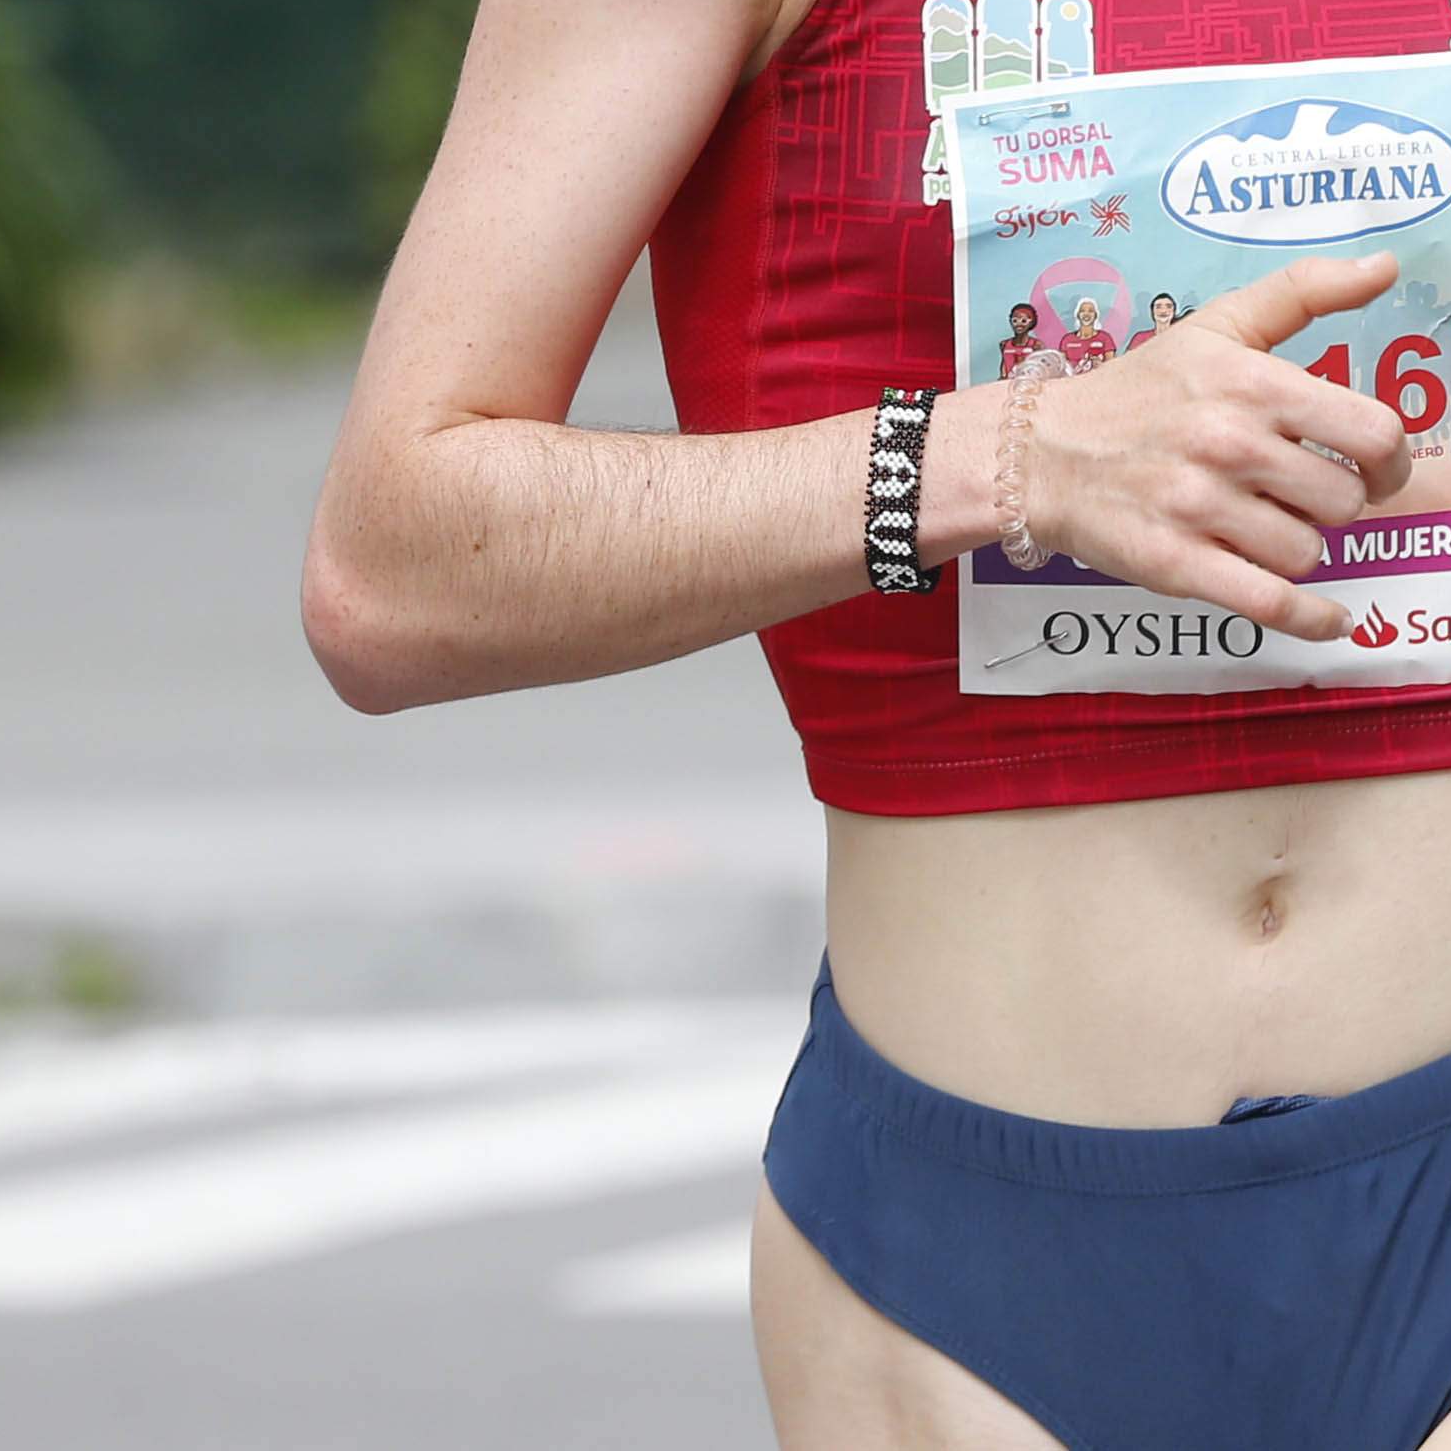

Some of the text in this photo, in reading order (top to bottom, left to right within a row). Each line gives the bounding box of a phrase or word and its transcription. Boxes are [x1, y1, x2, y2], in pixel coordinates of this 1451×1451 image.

[993, 122, 1113, 153] TU DORSAL
[1231, 141, 1434, 168] CENTRAL LECHERA
[999, 145, 1115, 185] SUMA
[1185, 160, 1445, 216] ASTURIANA
[994, 200, 1079, 238] gijón
[869, 406, 926, 592] LAUR
[1042, 611, 1263, 658] OYSHO
